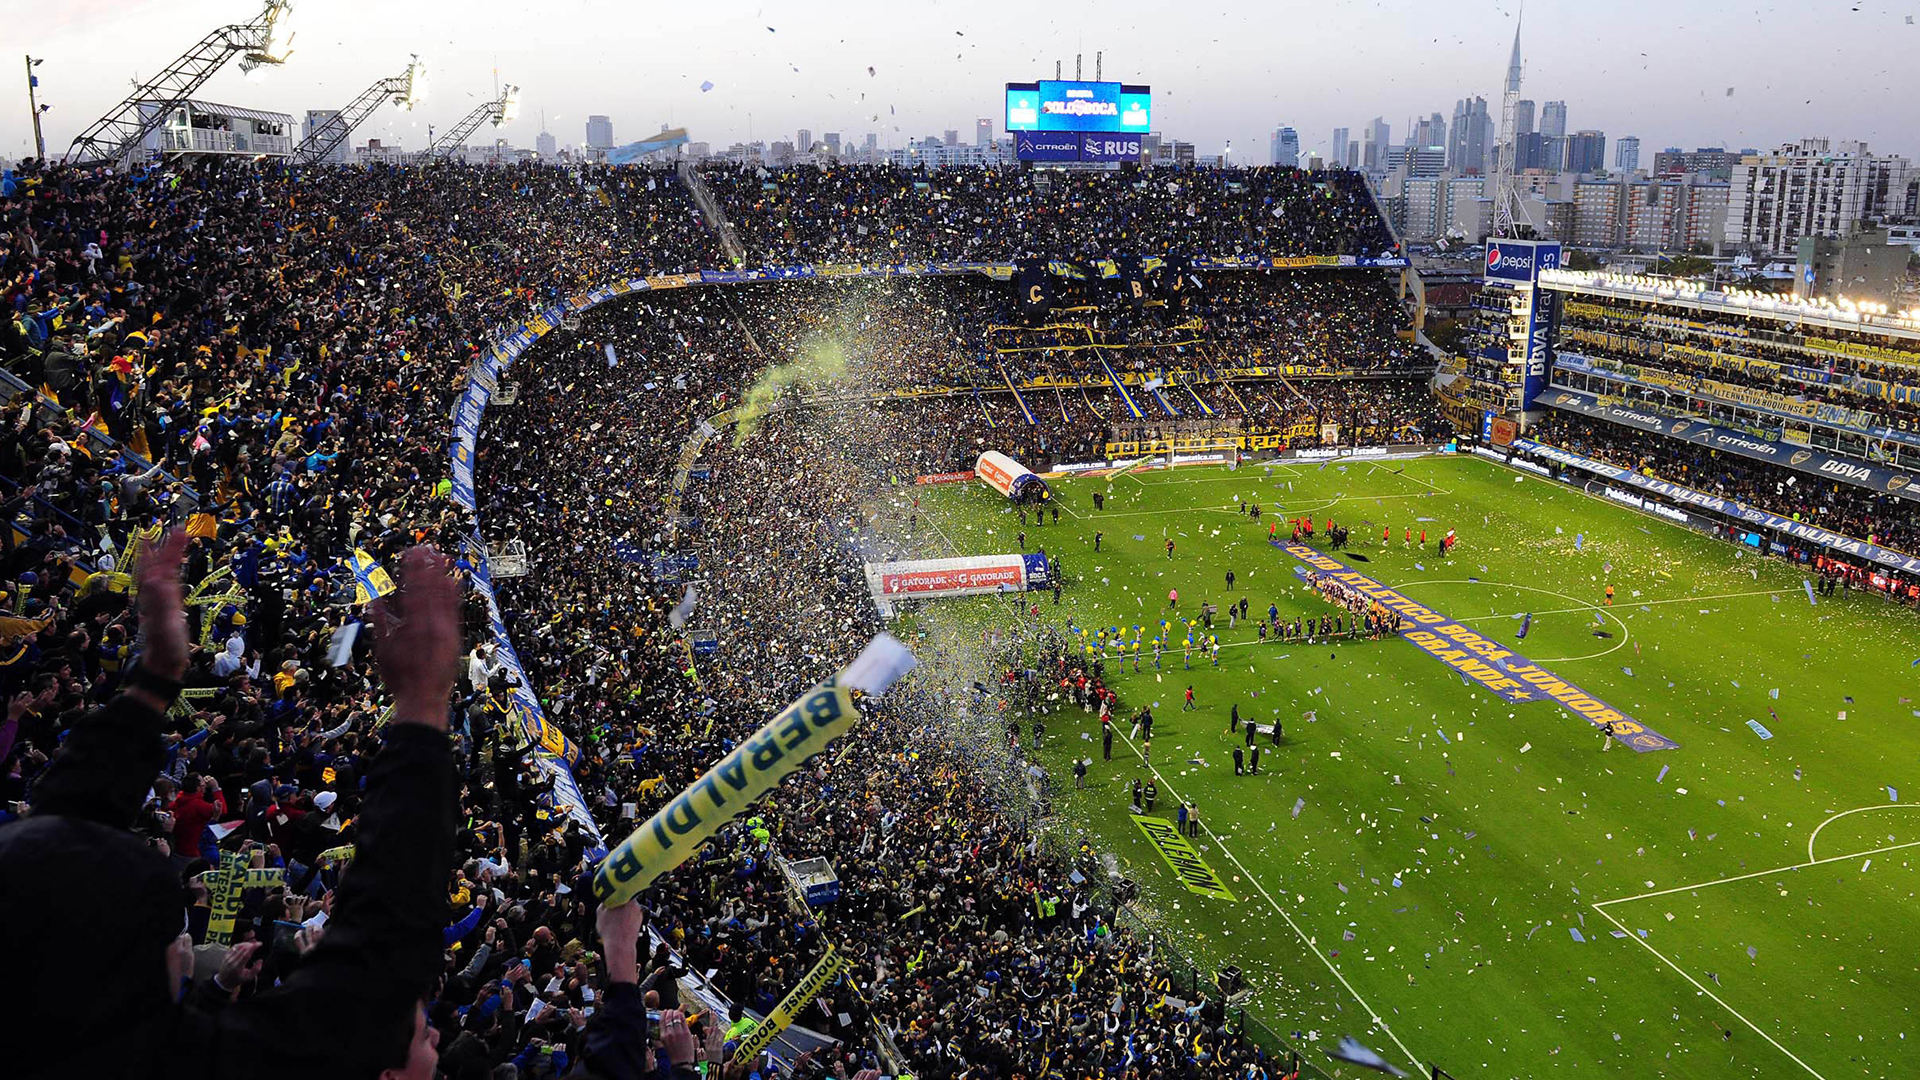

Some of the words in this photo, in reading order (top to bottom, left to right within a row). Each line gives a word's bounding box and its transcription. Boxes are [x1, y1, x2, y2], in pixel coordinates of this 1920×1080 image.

[1105, 141, 1139, 155] RUS
[1502, 256, 1532, 270] pepsi
[1130, 281, 1143, 298] B
[1530, 327, 1549, 376] BBVA
[1792, 369, 1826, 382] RONY
[1761, 399, 1804, 414] BOQUENSE
[1296, 448, 1338, 458] Publicidad
[1819, 459, 1872, 481] BBVA
[1605, 486, 1643, 508] Publicidad
[1645, 479, 1669, 495] LA
[1667, 484, 1726, 511] NUEVA
[1763, 516, 1794, 533] LA
[1791, 523, 1862, 554] NUEVA
[902, 576, 947, 586] GATORADE
[970, 571, 1014, 583] GATORADE
[1286, 546, 1344, 570] CLUB
[1331, 572, 1445, 623] ATLETICO
[1435, 624, 1514, 662] BOCA
[1507, 662, 1645, 735] JUNIORS
[1404, 631, 1523, 691] GRANDE
[653, 689, 844, 850] BERALDI
